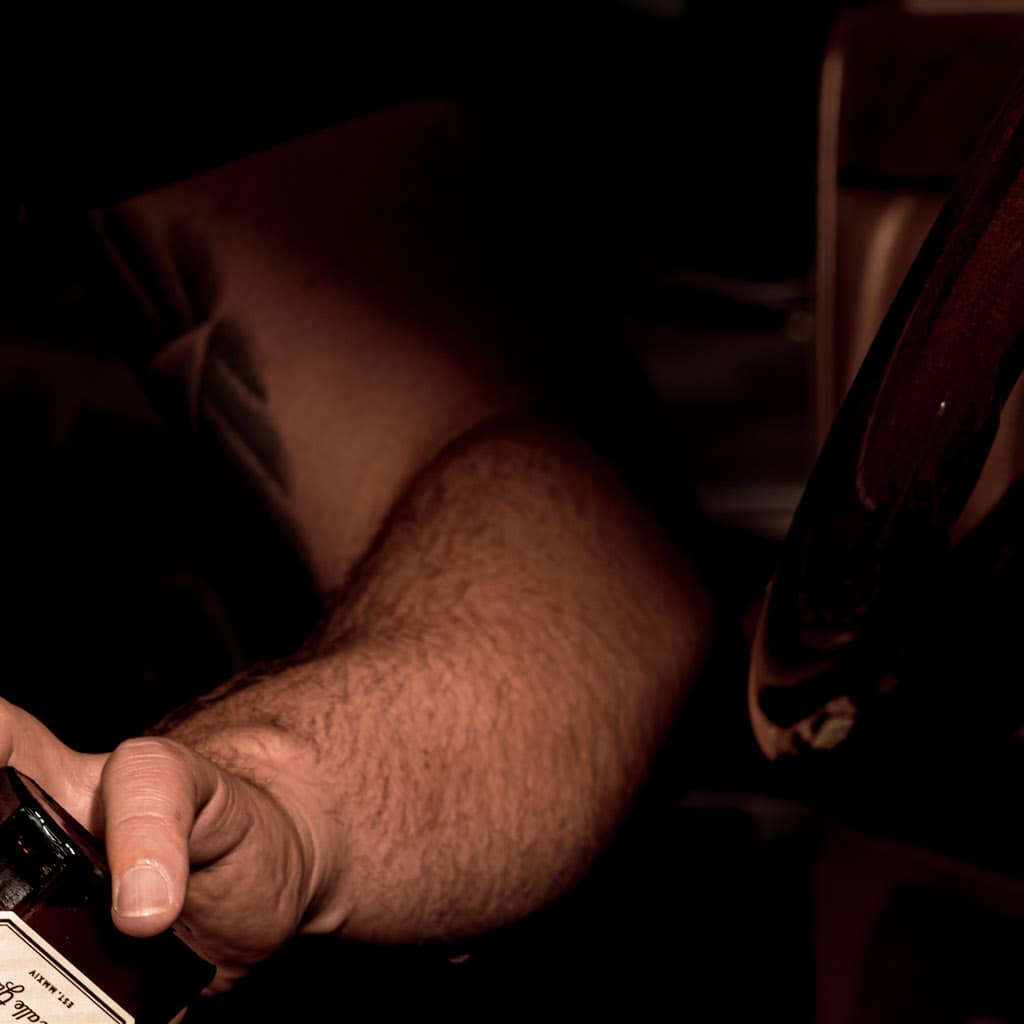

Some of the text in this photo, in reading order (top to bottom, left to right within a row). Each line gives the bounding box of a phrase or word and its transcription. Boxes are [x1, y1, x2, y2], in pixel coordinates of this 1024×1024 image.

[28, 970, 74, 1008] EST. MMXIV
[11, 999, 40, 1022] alle
